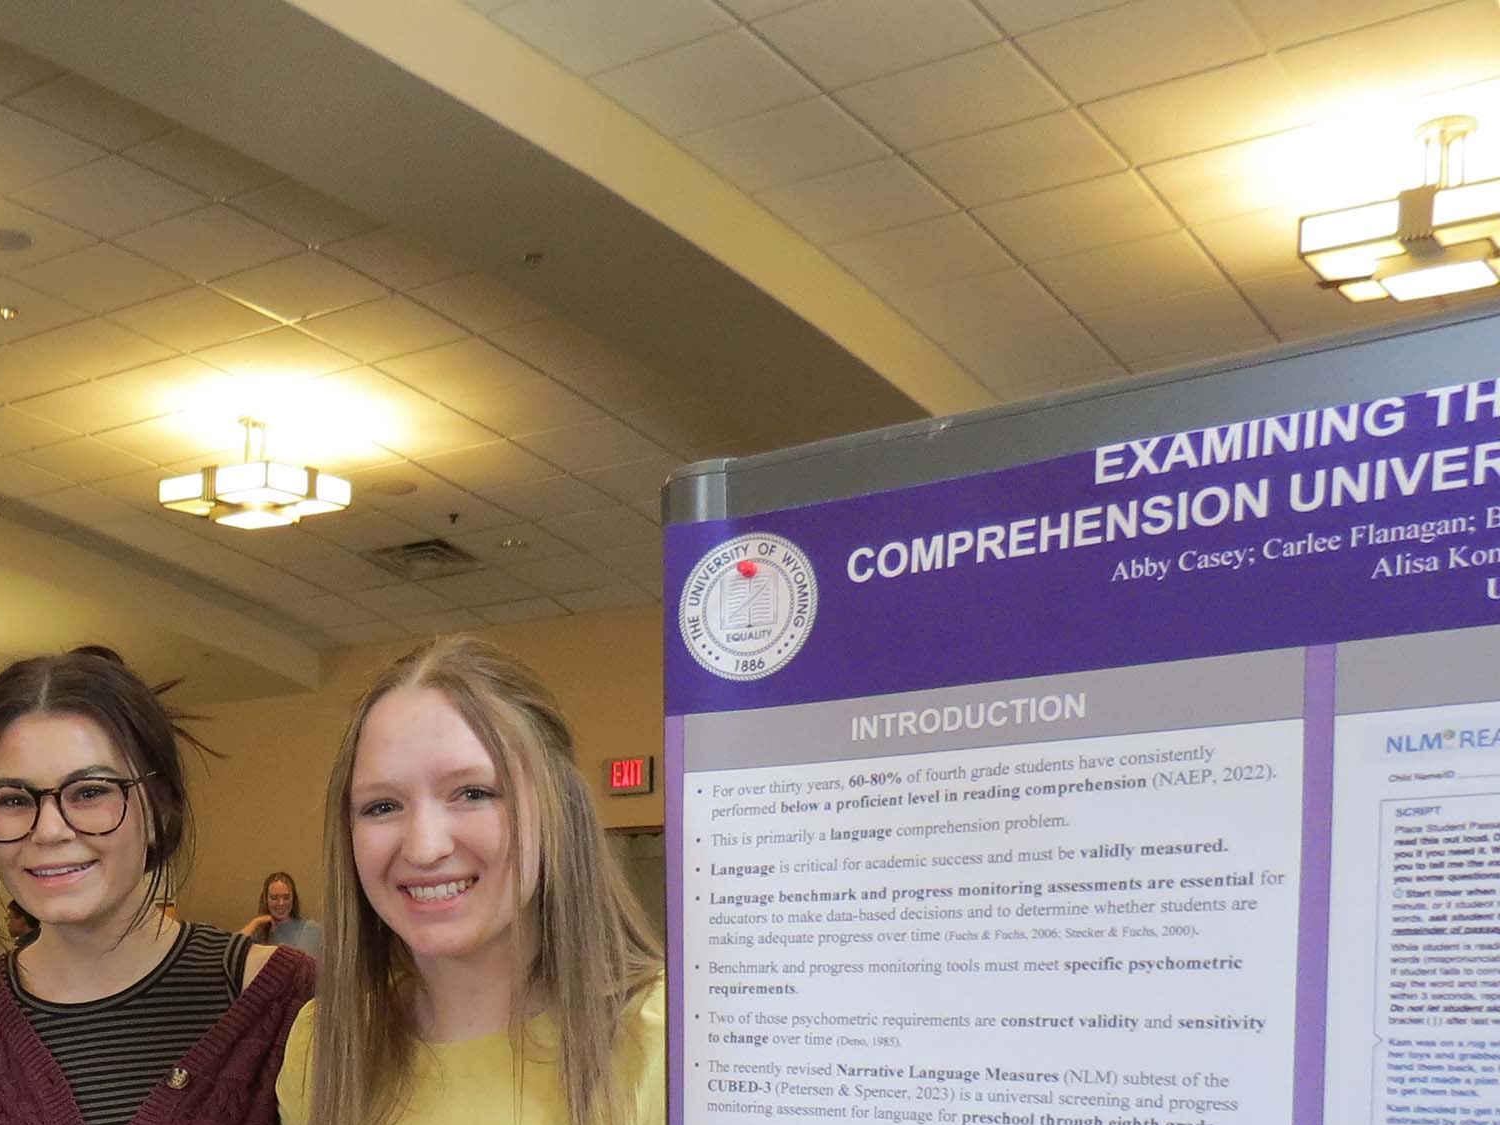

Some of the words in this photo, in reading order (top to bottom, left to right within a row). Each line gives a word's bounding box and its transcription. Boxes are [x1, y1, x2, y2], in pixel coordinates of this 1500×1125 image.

[1094, 397, 1406, 484] EXAMINING
[847, 479, 1268, 583] COMPREHENSION
[1112, 556, 1170, 581] Abby
[1178, 547, 1255, 571] Casey;
[1263, 532, 1341, 559] Carlee
[1351, 516, 1476, 548] Flanagan;
[758, 543, 777, 556] OF
[1372, 553, 1439, 579] Alisa
[689, 544, 750, 606] UNIVERSITY
[781, 551, 809, 628] WYOMING
[688, 616, 703, 640] THE
[726, 629, 772, 642] EQUALITY
[735, 658, 765, 672] 1886
[852, 693, 1085, 741] INTRODUCTION
[1387, 732, 1442, 753] NLM
[612, 759, 644, 787] EXIT
[713, 785, 734, 798] For
[737, 785, 765, 796] over
[769, 780, 802, 795] thirty
[808, 780, 844, 794] years,
[848, 771, 902, 788] 60-80%
[907, 769, 922, 783] of
[926, 766, 966, 782] fourth
[971, 762, 1010, 782] grade
[1015, 758, 1074, 774] students
[1079, 755, 1115, 769] have
[1119, 745, 1214, 766] consistently
[712, 801, 776, 821] performed
[781, 795, 819, 813] below
[824, 802, 831, 810] a
[836, 795, 903, 813] proficient
[908, 790, 940, 805] level
[945, 789, 958, 802] in
[963, 784, 1020, 802] reading
[1025, 775, 1147, 797] comprehension
[1152, 769, 1216, 788] (NAEP,
[1224, 764, 1276, 781] 2022).
[711, 833, 738, 847] This
[742, 832, 752, 845] is
[756, 829, 814, 848] primarily
[819, 832, 826, 841] a
[830, 828, 892, 842] language
[896, 818, 1000, 838] comprehension
[1005, 814, 1068, 834] problem.
[711, 864, 775, 878] Language
[780, 860, 789, 873] is
[794, 858, 837, 873] critical
[843, 858, 861, 871] for
[865, 855, 926, 869] academic
[932, 854, 983, 866] success
[988, 849, 1013, 863] and
[1018, 849, 1053, 862] must
[1058, 846, 1075, 860] be
[1080, 843, 1134, 860] validly
[1140, 838, 1228, 856] measured.
[710, 892, 774, 907] Language
[779, 888, 856, 902] benchmark
[861, 887, 887, 900] and
[892, 888, 953, 903] progress
[958, 881, 1042, 897] monitoring
[1048, 879, 1142, 893] assessments
[1148, 879, 1174, 889] are
[1180, 871, 1253, 888] essential
[1261, 870, 1284, 885] for
[709, 961, 778, 974] Benchmark
[782, 961, 805, 973] and
[809, 963, 864, 977] progress
[868, 959, 942, 976] monitoring
[947, 959, 980, 972] tools
[985, 960, 1019, 972] must
[1024, 960, 1059, 971] meet
[1064, 956, 1123, 975] specific
[1128, 955, 1243, 974] psychometric
[708, 1100, 772, 1118] monitoring
[777, 1106, 846, 1117] assessment
[852, 1105, 869, 1118] for
[874, 1106, 932, 1125] language
[939, 1108, 957, 1122] for
[962, 1112, 1034, 1125] preschool
